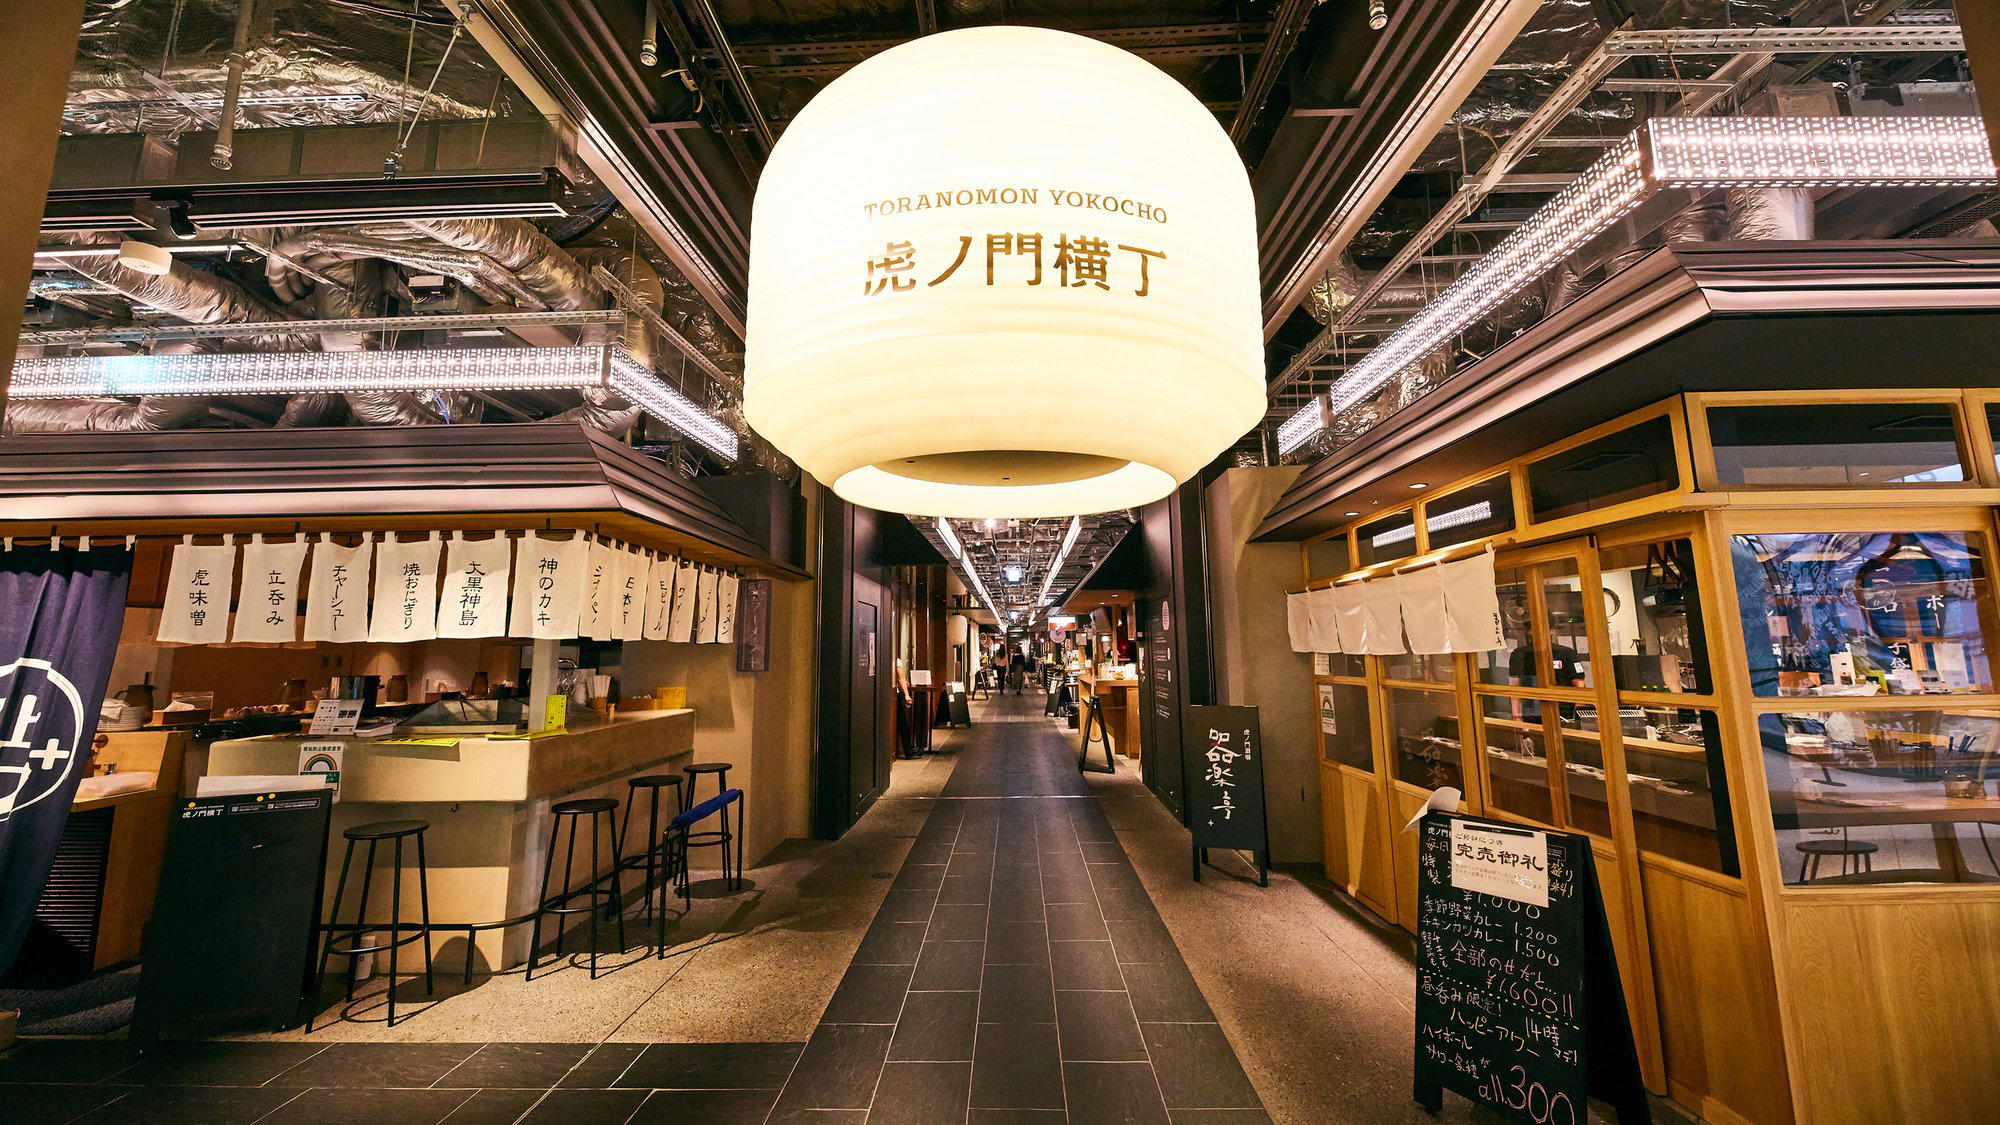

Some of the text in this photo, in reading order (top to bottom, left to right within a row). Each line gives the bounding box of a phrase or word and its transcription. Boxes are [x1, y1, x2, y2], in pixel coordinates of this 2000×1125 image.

[864, 188, 1167, 224] TORANOMON YOKOCHO
[863, 231, 1167, 297] 虎ノ門横丁
[266, 570, 286, 626] 立呑み
[331, 565, 347, 631] チャーシュー
[403, 562, 421, 630] 焼おにぎり
[459, 560, 486, 627] 大黒神島
[538, 558, 558, 627] 神のカキ
[1455, 843, 1543, 871] 完売御礼
[1421, 914, 1504, 943] チキンカツカレー
[1423, 894, 1502, 928] 季節野菜カレー
[1423, 1024, 1473, 1050] ハイボール
[1450, 1007, 1541, 1057] ハッピーアワー
